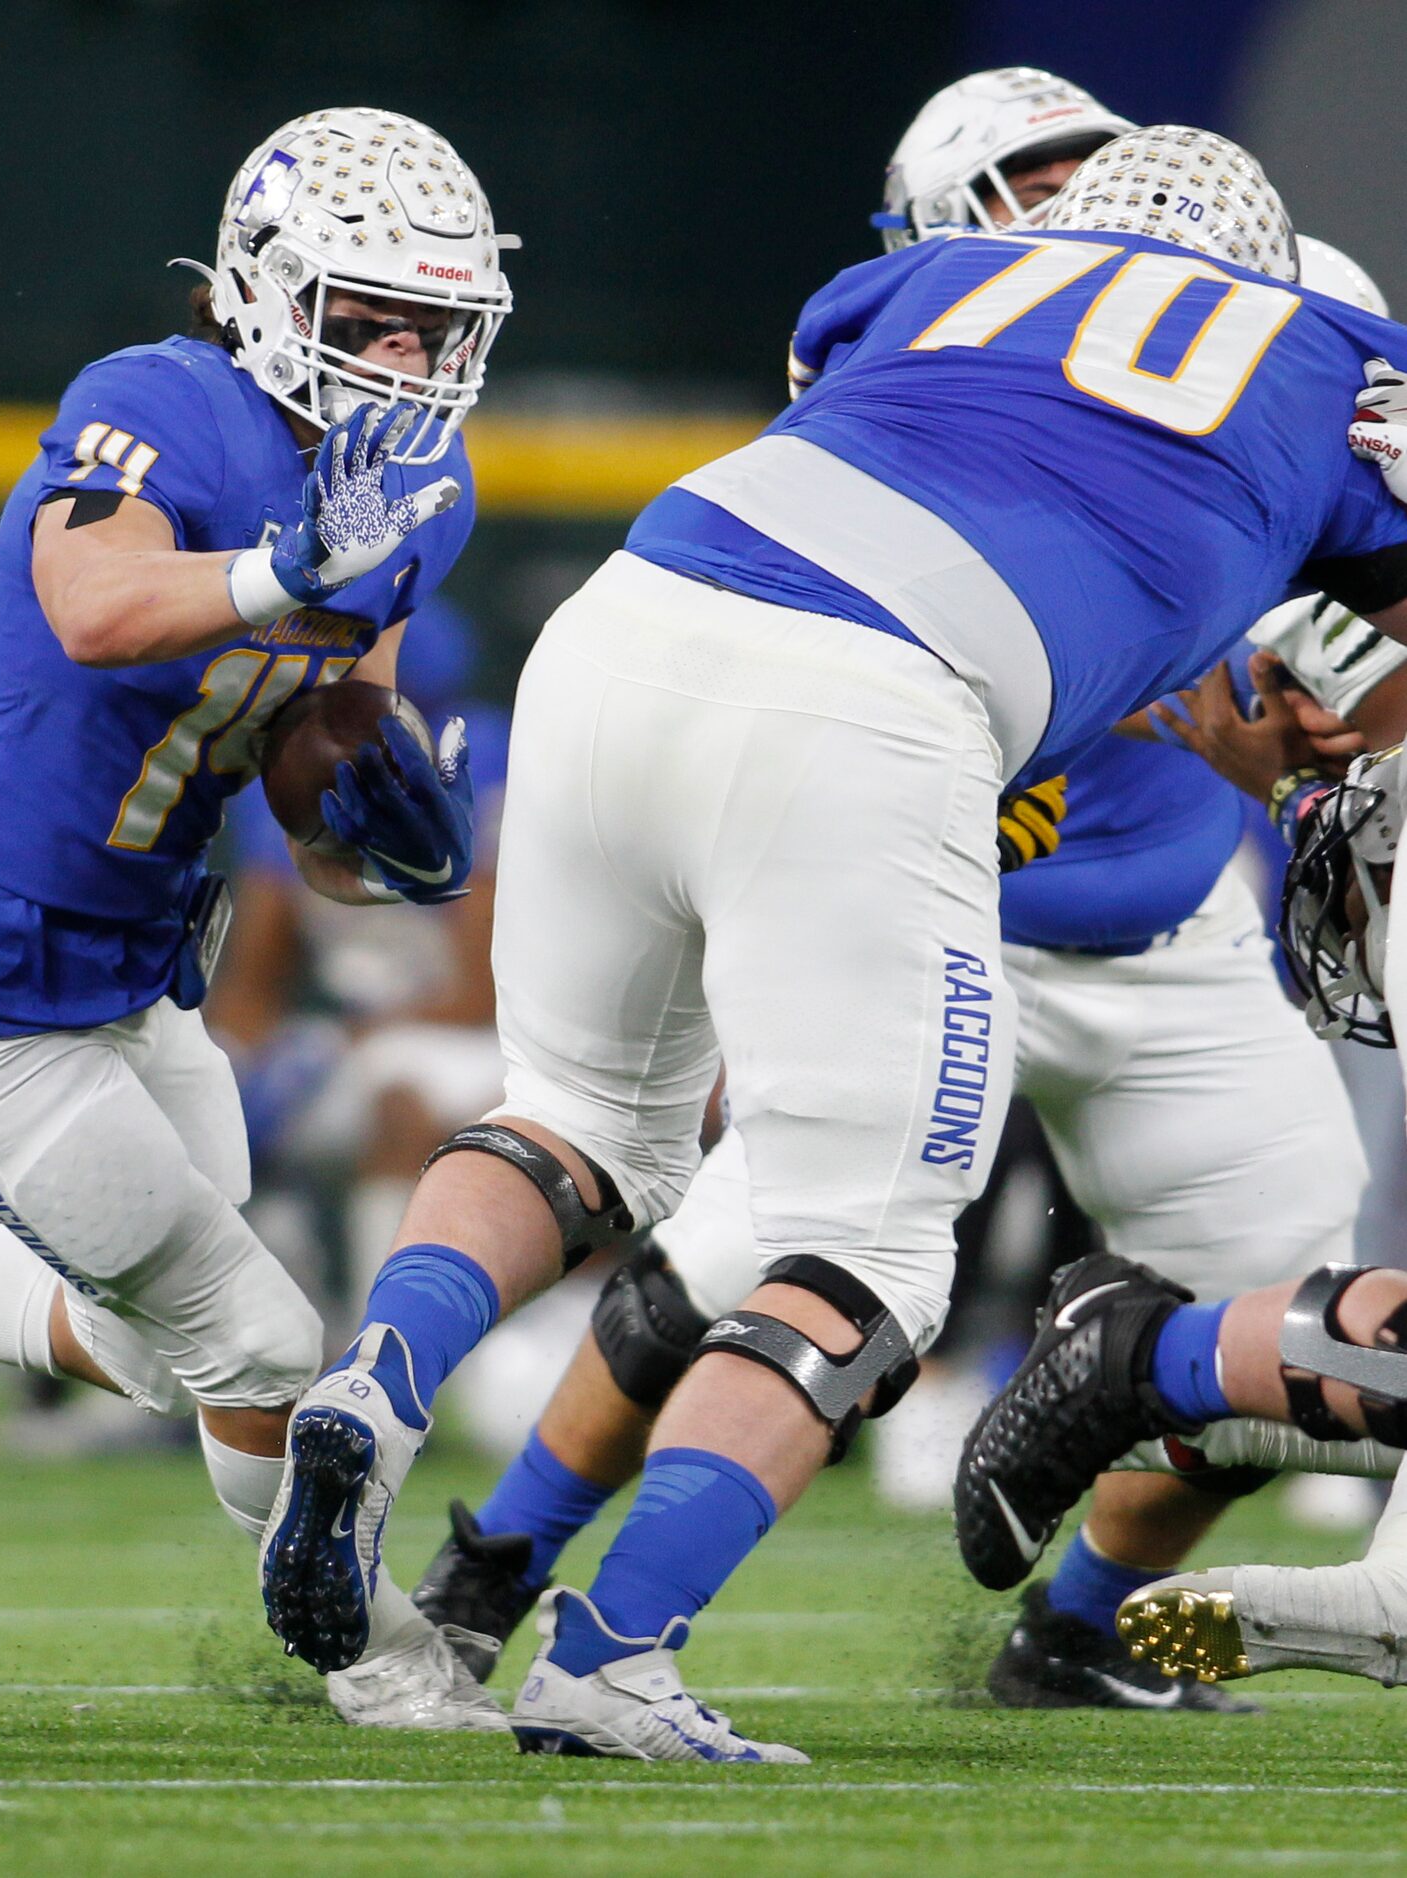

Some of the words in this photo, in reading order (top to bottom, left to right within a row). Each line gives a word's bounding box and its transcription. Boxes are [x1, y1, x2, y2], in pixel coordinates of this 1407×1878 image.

[1175, 195, 1204, 222] 70
[417, 261, 473, 283] Riddell
[906, 232, 1302, 437] 70
[66, 421, 160, 497] 14
[921, 946, 994, 1172] RACCOONS
